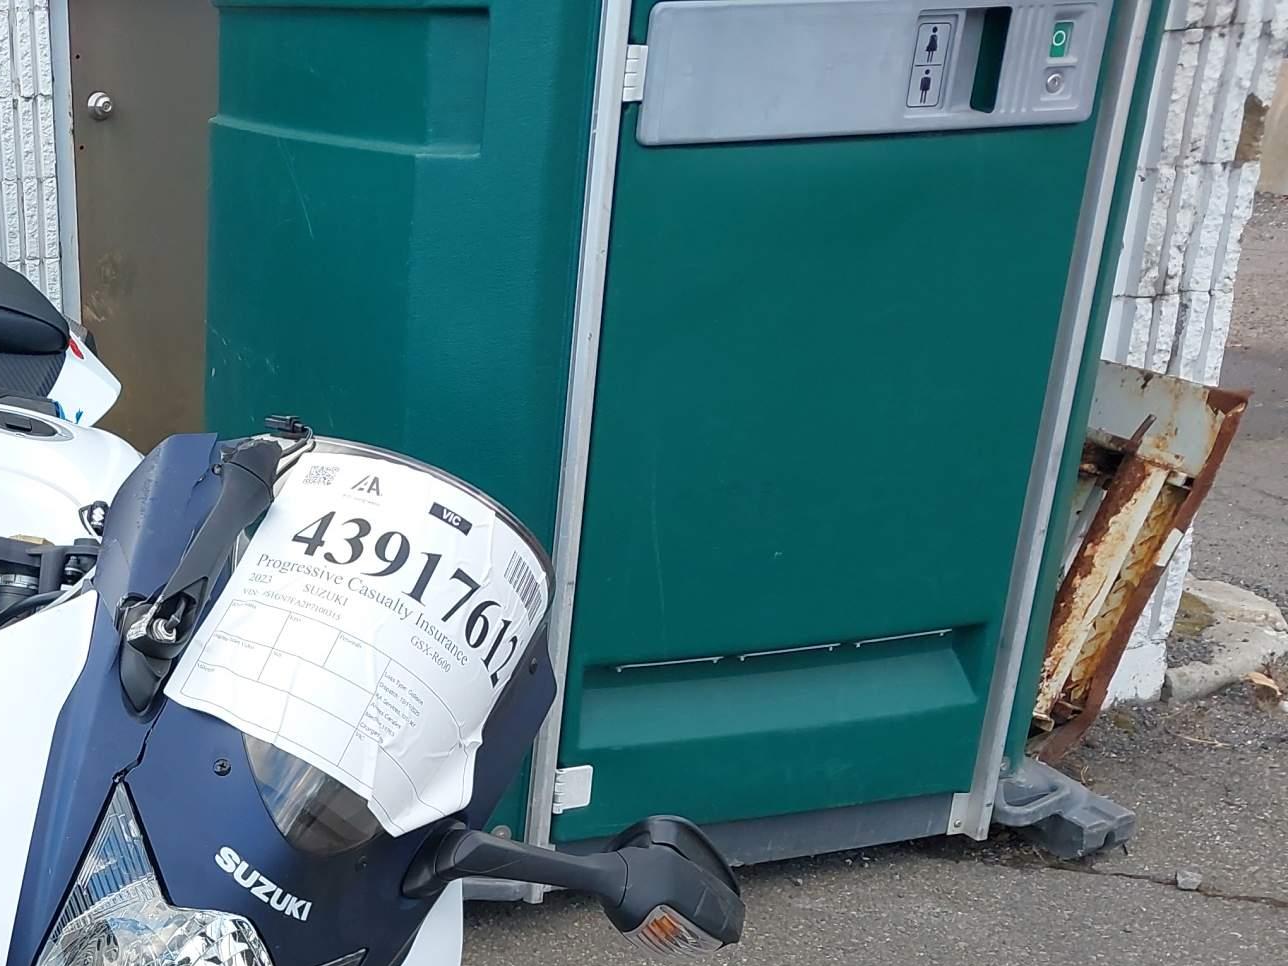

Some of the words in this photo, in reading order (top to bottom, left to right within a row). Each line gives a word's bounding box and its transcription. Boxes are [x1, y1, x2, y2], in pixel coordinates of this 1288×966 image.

[441, 508, 462, 527] VIC
[257, 553, 344, 585] Progressive
[347, 576, 414, 621] Casualty
[415, 612, 469, 667] Insurance
[291, 510, 518, 689] 43917612
[303, 583, 349, 607] SUZUKI
[410, 635, 452, 673] GSX-R600
[214, 846, 313, 921] SUZUKI
